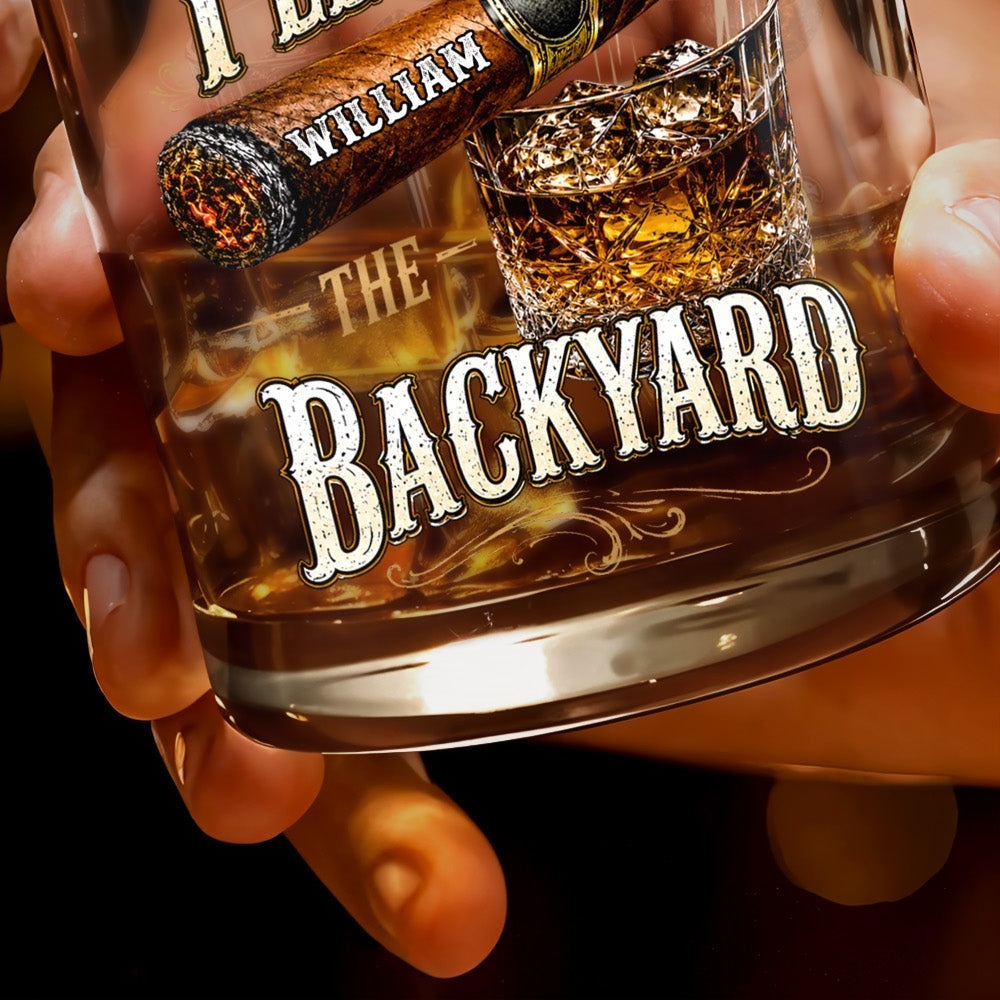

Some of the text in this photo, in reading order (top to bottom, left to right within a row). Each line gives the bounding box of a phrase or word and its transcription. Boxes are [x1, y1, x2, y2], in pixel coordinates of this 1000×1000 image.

[285, 30, 492, 166] WILLIAM
[319, 236, 431, 338] THE
[258, 278, 867, 588] BACKYARD
